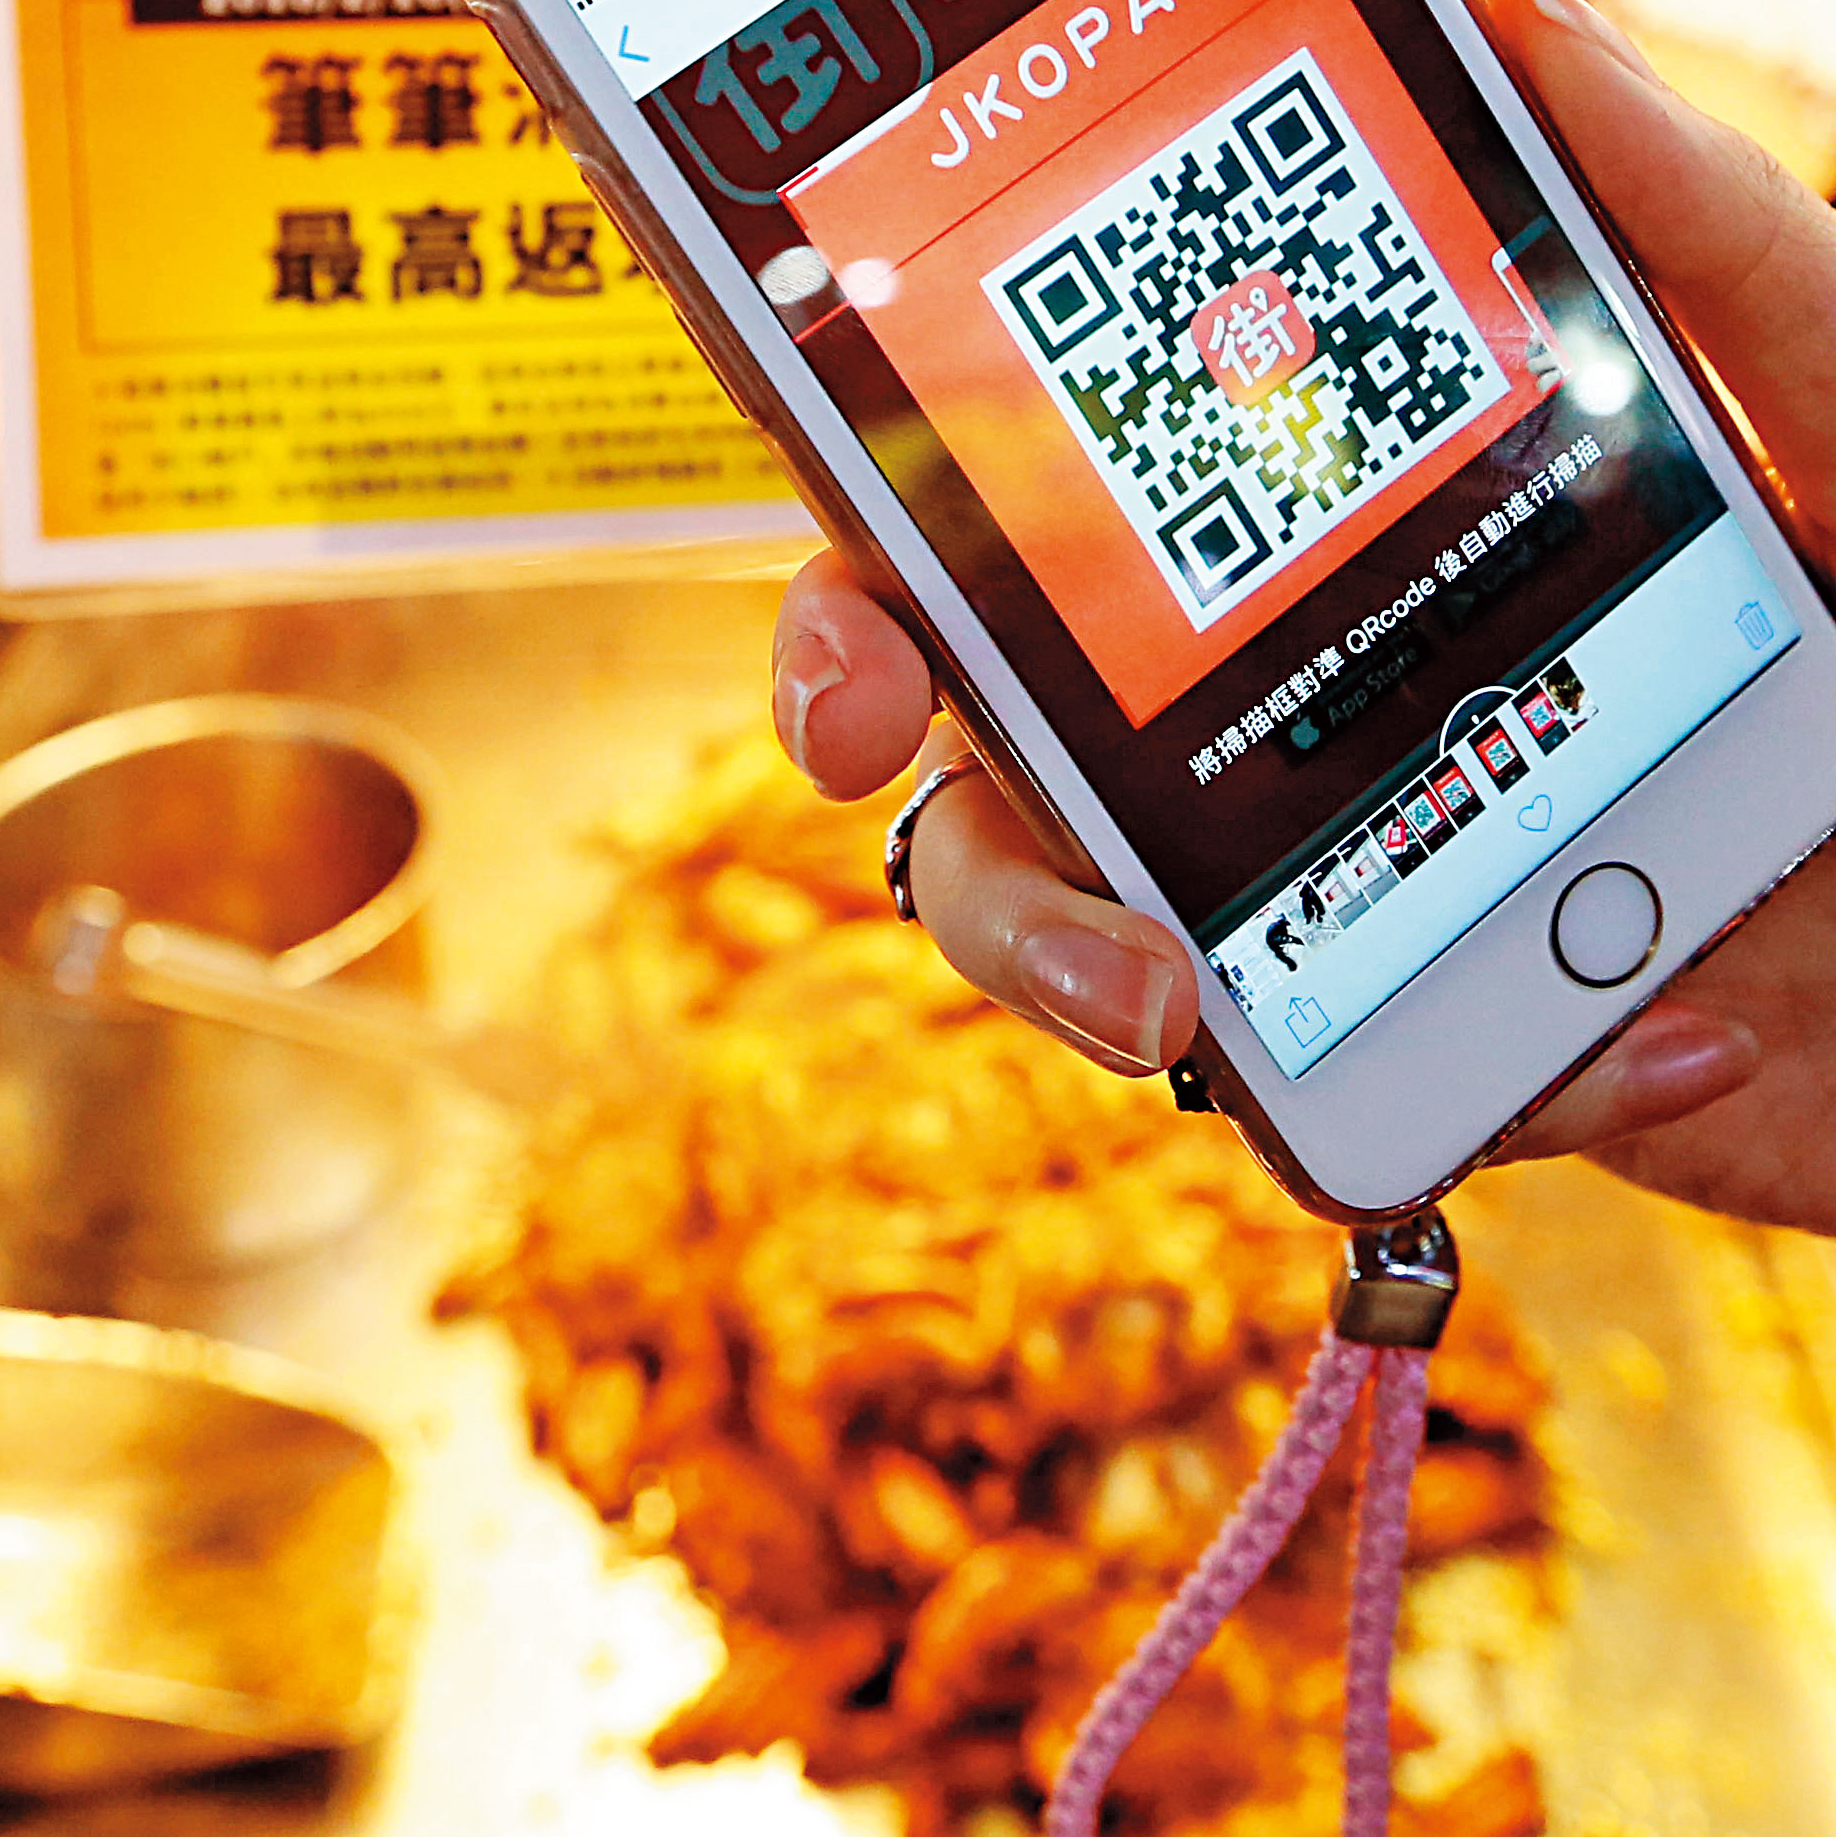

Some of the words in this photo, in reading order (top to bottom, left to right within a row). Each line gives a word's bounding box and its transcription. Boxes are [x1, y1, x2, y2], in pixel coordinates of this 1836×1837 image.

[273, 200, 651, 305] 最高返
[1207, 287, 1297, 388] 街
[1188, 646, 1345, 786] 將掃描框對準
[1345, 575, 1437, 654] QRcode
[1434, 433, 1604, 583] 後自動進行掃描
